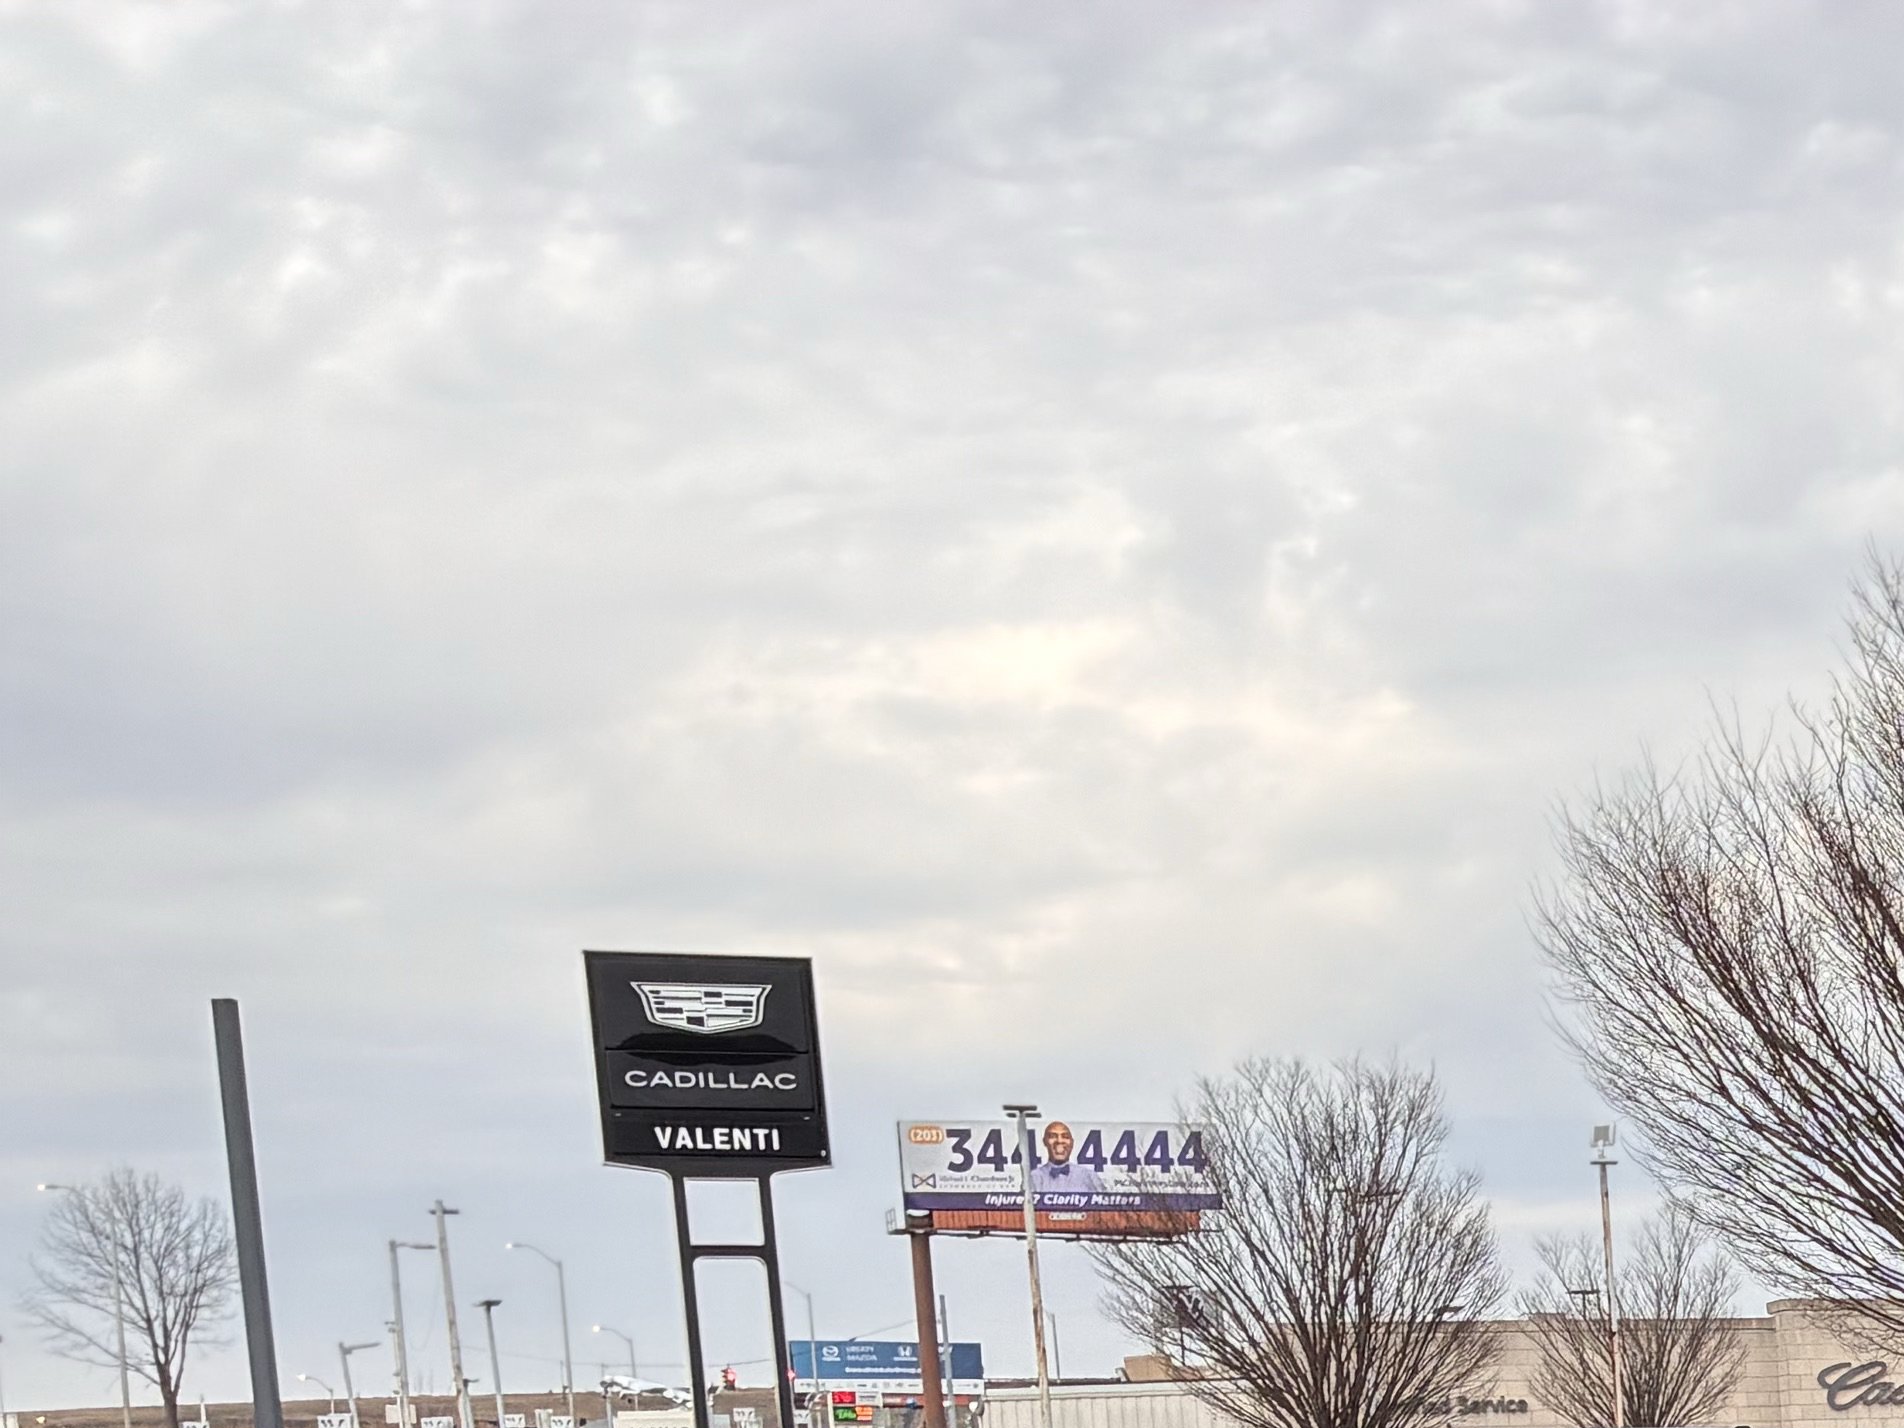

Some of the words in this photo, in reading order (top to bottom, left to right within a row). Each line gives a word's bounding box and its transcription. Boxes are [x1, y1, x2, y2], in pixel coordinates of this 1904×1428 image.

[624, 1071, 797, 1090] CADILLAC
[654, 1126, 781, 1151] VALENTI
[910, 1128, 943, 1143] (203)
[1077, 1129, 1208, 1174] 4444
[985, 1194, 1041, 1207] Injure?
[1044, 1194, 1088, 1208] Clarity
[1091, 1195, 1141, 1206] Matters
